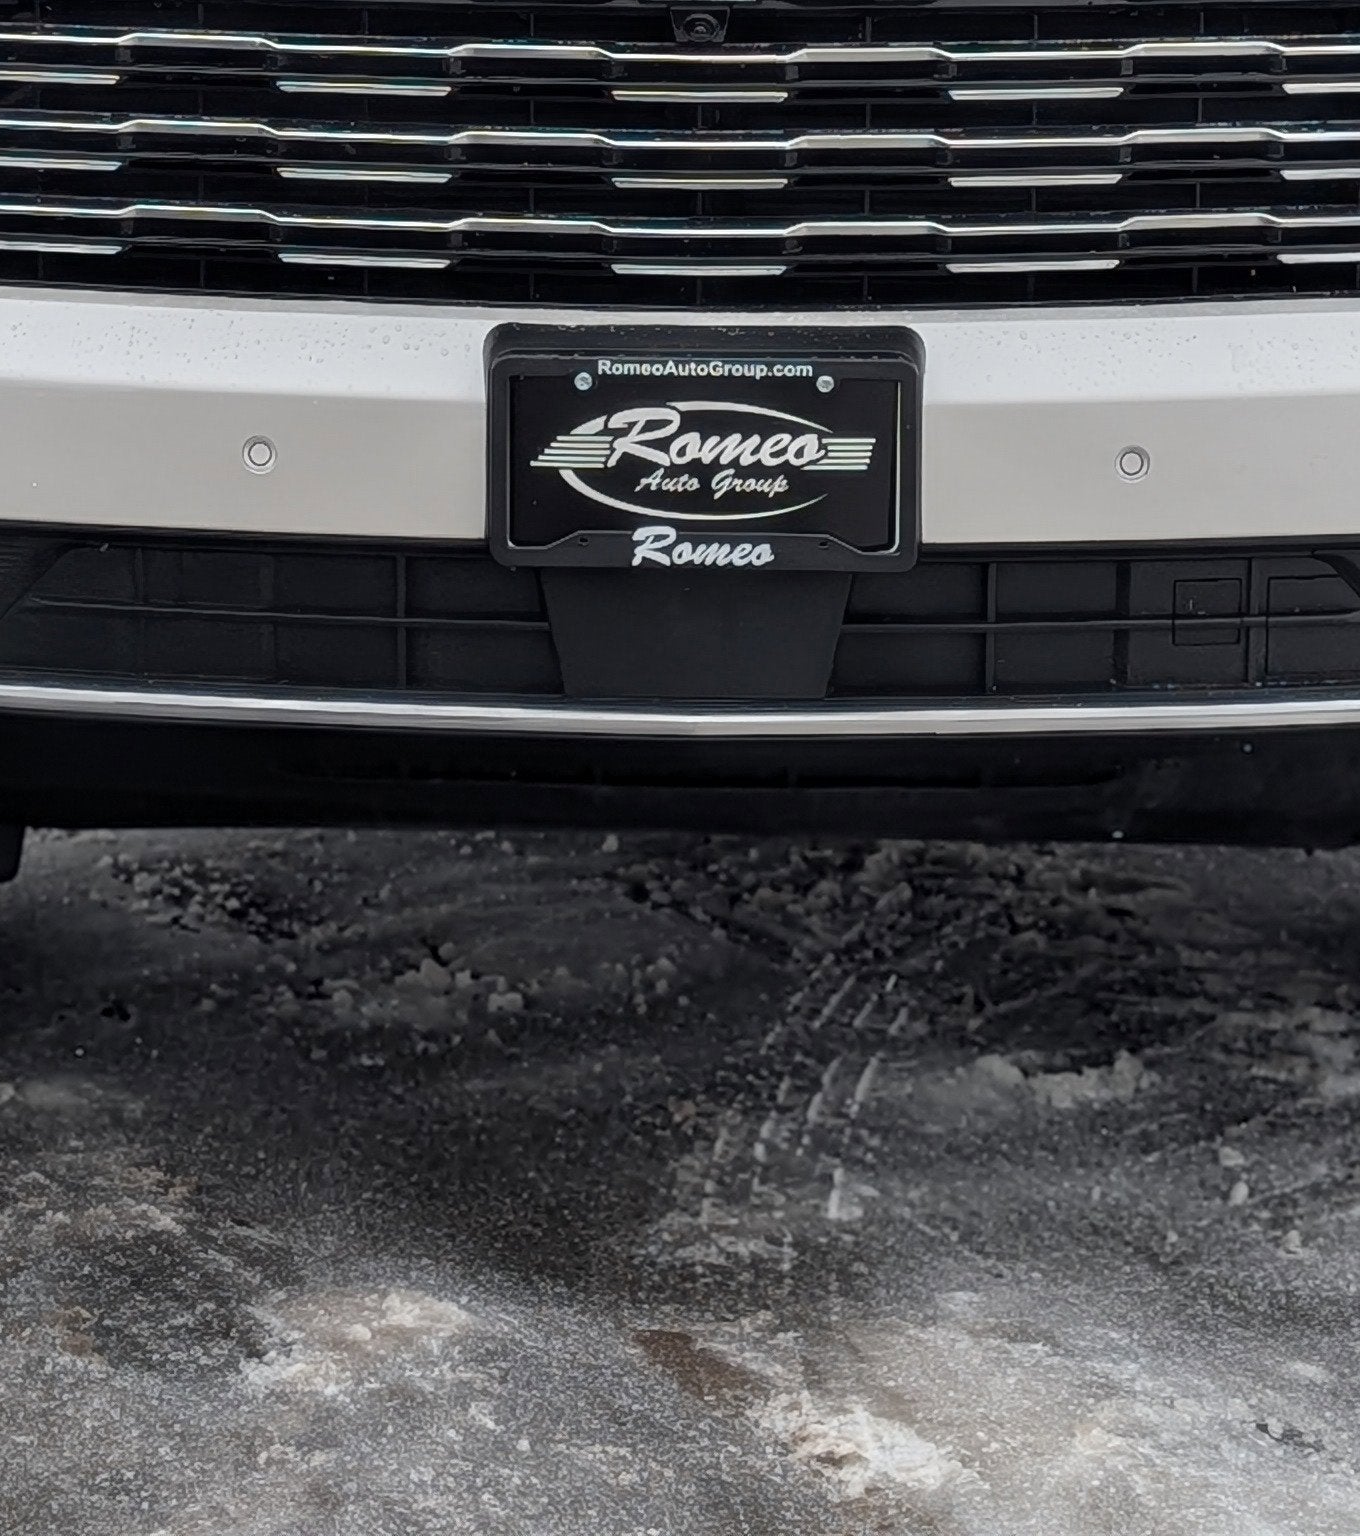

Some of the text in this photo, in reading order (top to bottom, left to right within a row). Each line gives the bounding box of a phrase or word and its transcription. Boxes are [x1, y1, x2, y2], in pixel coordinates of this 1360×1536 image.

[597, 359, 814, 381] RomeoAutoGroup.com
[607, 406, 827, 469] Romeo
[634, 468, 790, 500] Auto Group
[631, 525, 775, 567] Romeo
